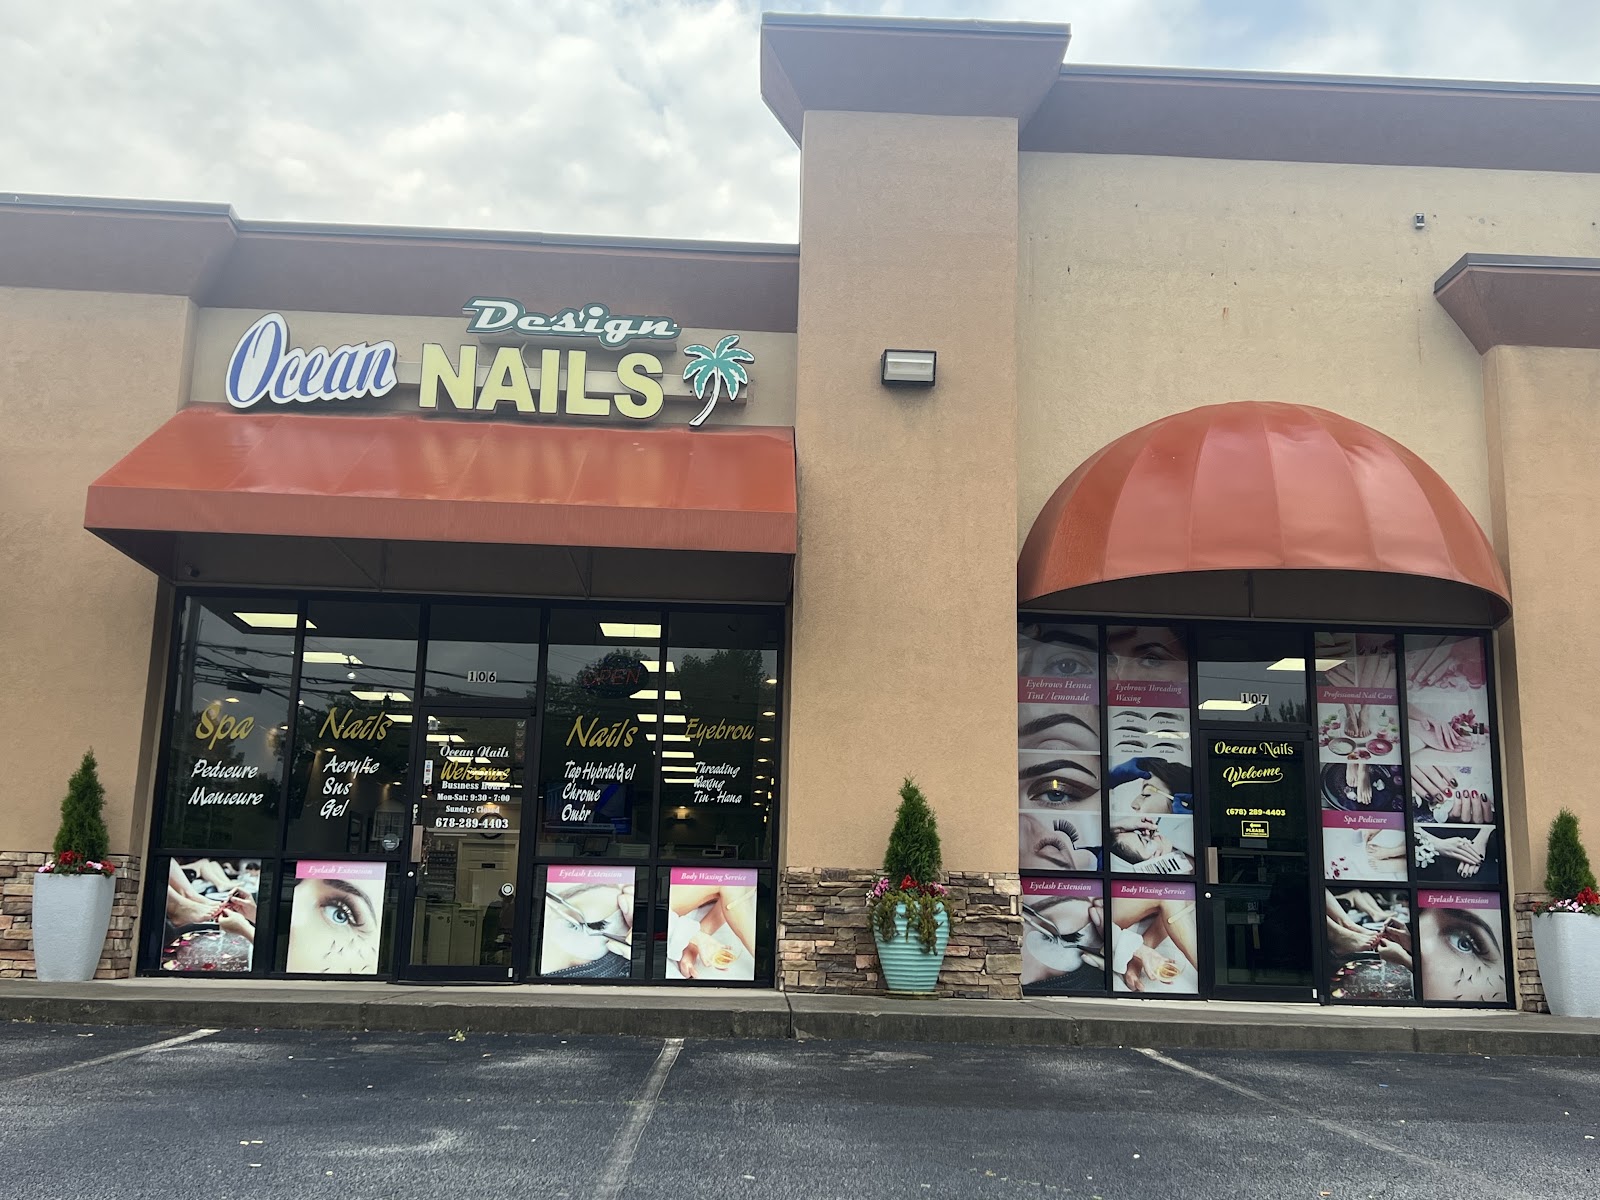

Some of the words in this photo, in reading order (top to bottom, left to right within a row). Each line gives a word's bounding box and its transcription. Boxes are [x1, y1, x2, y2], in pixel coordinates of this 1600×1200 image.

[466, 297, 680, 346] Design
[226, 313, 396, 407] Ocean
[419, 344, 663, 419] NAILS
[468, 671, 497, 683] 106
[1026, 679, 1063, 689] Eyebrows
[1064, 680, 1092, 689] Henna
[1115, 683, 1146, 693] Eyebrows
[1148, 685, 1182, 694] Threading
[1027, 692, 1045, 700] Tint
[1050, 691, 1090, 701] lemonade
[1115, 694, 1142, 704] Waxing
[1241, 693, 1268, 705] 107
[1323, 690, 1361, 699] Professional
[1362, 691, 1377, 699] Nail
[1378, 692, 1393, 700] Care
[195, 704, 254, 750] Spa
[318, 707, 394, 741] Nails
[565, 715, 639, 748] Nails
[440, 745, 474, 757] Ocean
[476, 745, 510, 758] Nails
[1214, 741, 1258, 755] Ocean
[1259, 742, 1294, 758] Nails
[190, 759, 258, 779] Pedicure
[322, 755, 380, 778] Acrylic
[440, 760, 511, 781] Welcome
[695, 761, 741, 779] Threading
[1222, 765, 1284, 788] Welcome
[441, 780, 480, 790] Business
[188, 787, 264, 807] Manicure
[437, 793, 469, 801] Mon-Sat:
[469, 794, 488, 802] 9:30
[493, 794, 511, 802] 7:00
[562, 782, 601, 802] Chrome
[320, 799, 349, 818] Gel
[445, 804, 475, 814] Sunday:
[1226, 808, 1247, 816] (678)
[1248, 808, 1286, 816] 289-4403
[435, 817, 509, 829] 678-289-4403
[1343, 815, 1357, 824] Spa
[1357, 815, 1388, 824] Pedicure
[308, 865, 336, 876] Eyelash
[336, 866, 373, 875] Extension
[558, 869, 586, 879] Eyelash
[587, 869, 623, 878] Extension
[680, 872, 698, 881] Body
[699, 873, 723, 883] Waxing
[723, 873, 747, 881] Service
[1029, 881, 1056, 891] Eyelash
[1056, 882, 1092, 891] Extension
[1121, 885, 1137, 895] Body
[1138, 886, 1163, 896] Waxing
[1163, 887, 1187, 895] Service
[1427, 894, 1454, 904] Eyelash
[1455, 895, 1490, 904] Extension
